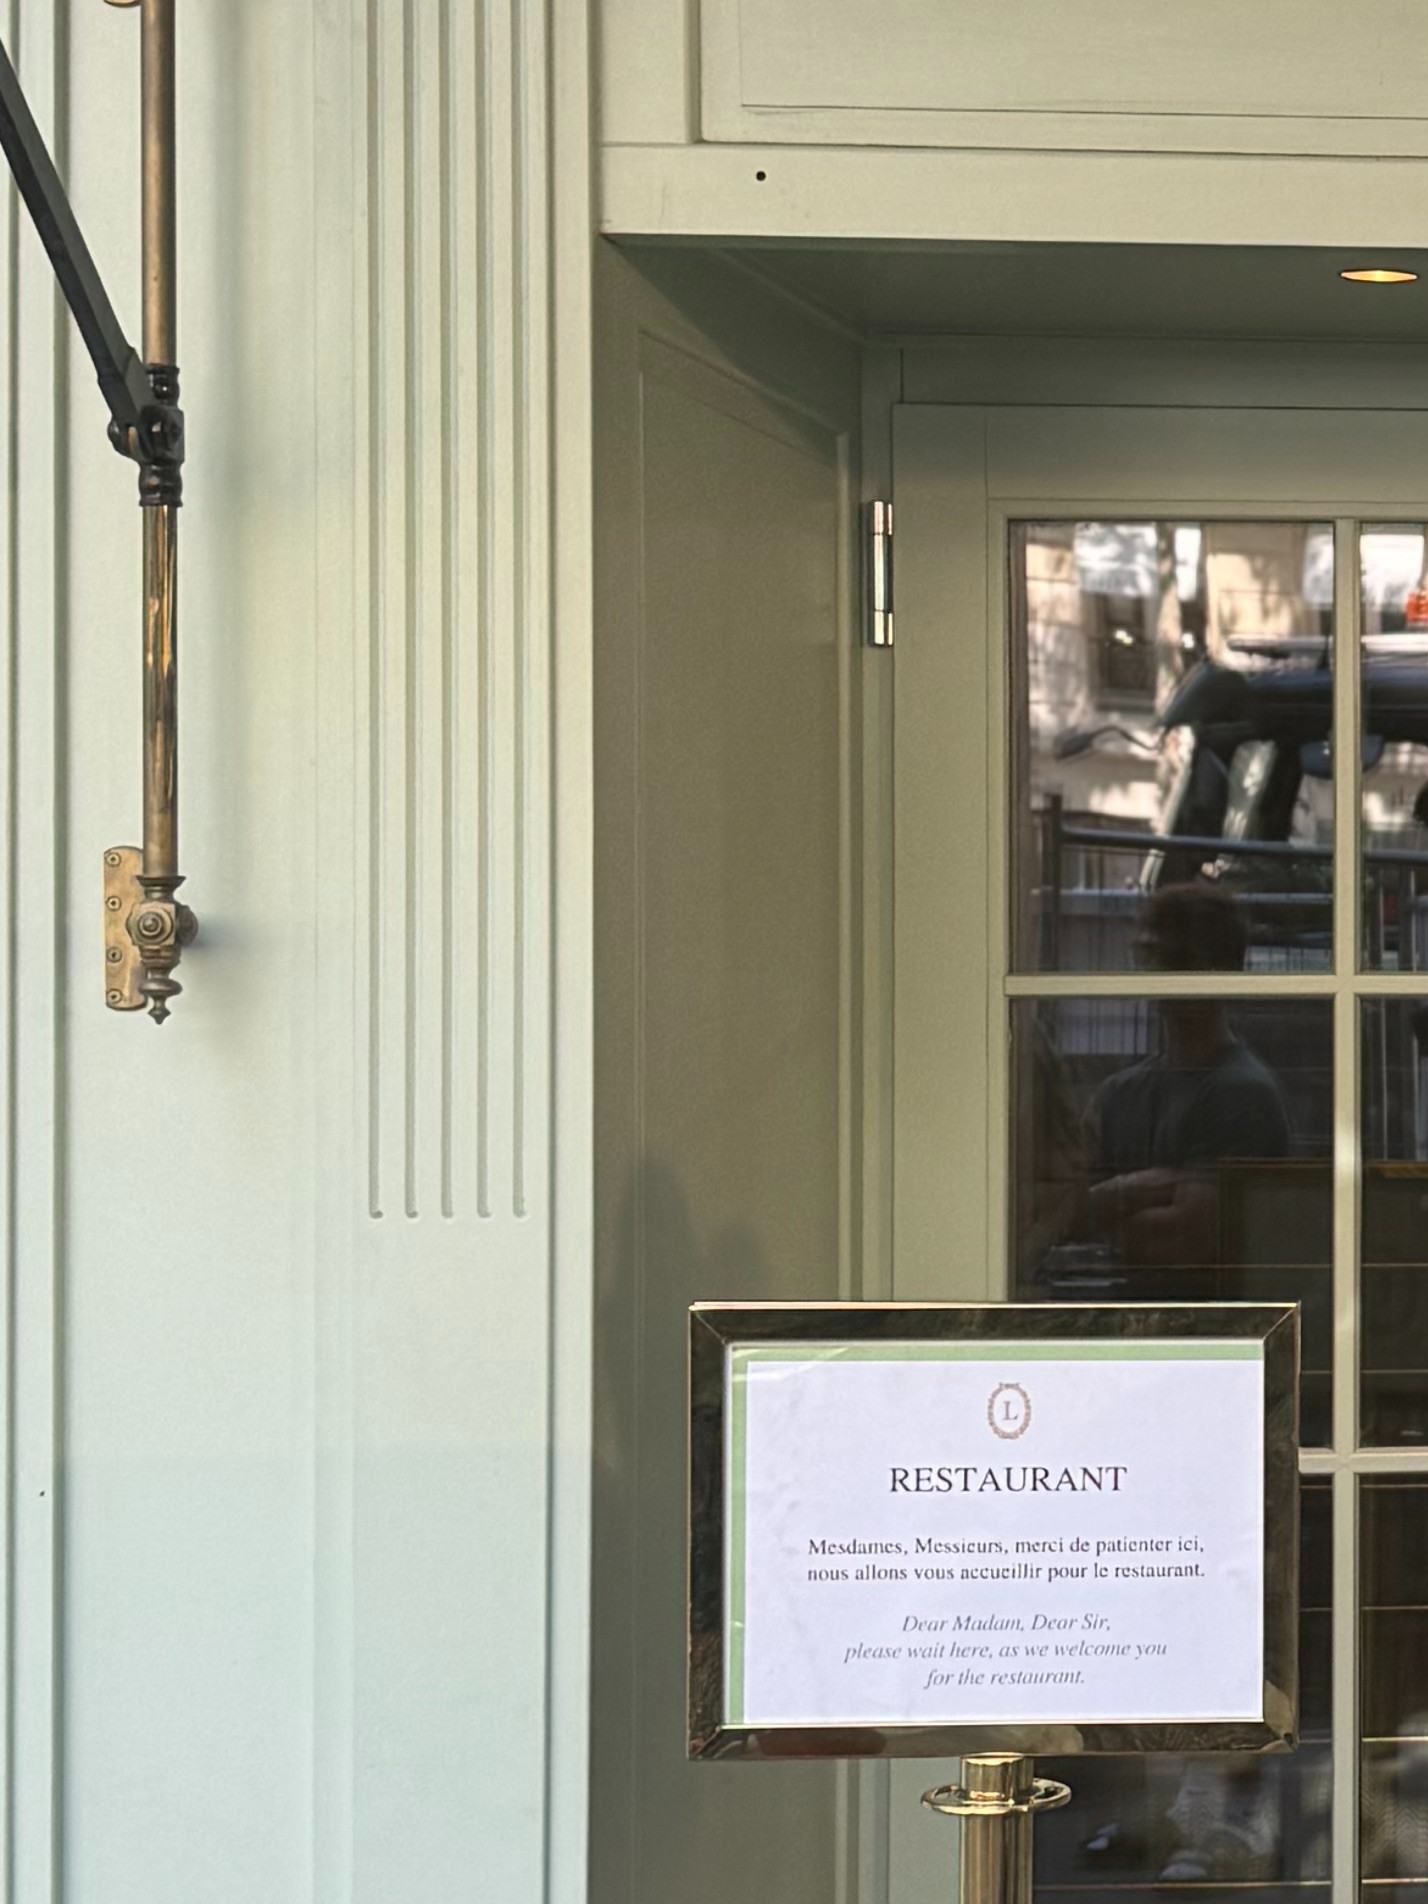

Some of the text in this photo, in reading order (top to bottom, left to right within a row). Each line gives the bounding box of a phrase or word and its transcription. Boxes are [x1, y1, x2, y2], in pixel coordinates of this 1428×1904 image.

[1002, 1400, 1019, 1421] L
[889, 1465, 1128, 1493] RESTAURANT
[808, 1534, 1205, 1558] Mesdames, Messieurs, merci de patienter ici,
[807, 1561, 1206, 1584] nous allons vous accueillir pour le restaurant.
[902, 1612, 1111, 1632] Dear Madam, Dear Sir,
[843, 1639, 1168, 1664] please wait here, as we welcome you
[922, 1667, 1085, 1690] for the restaurant.
